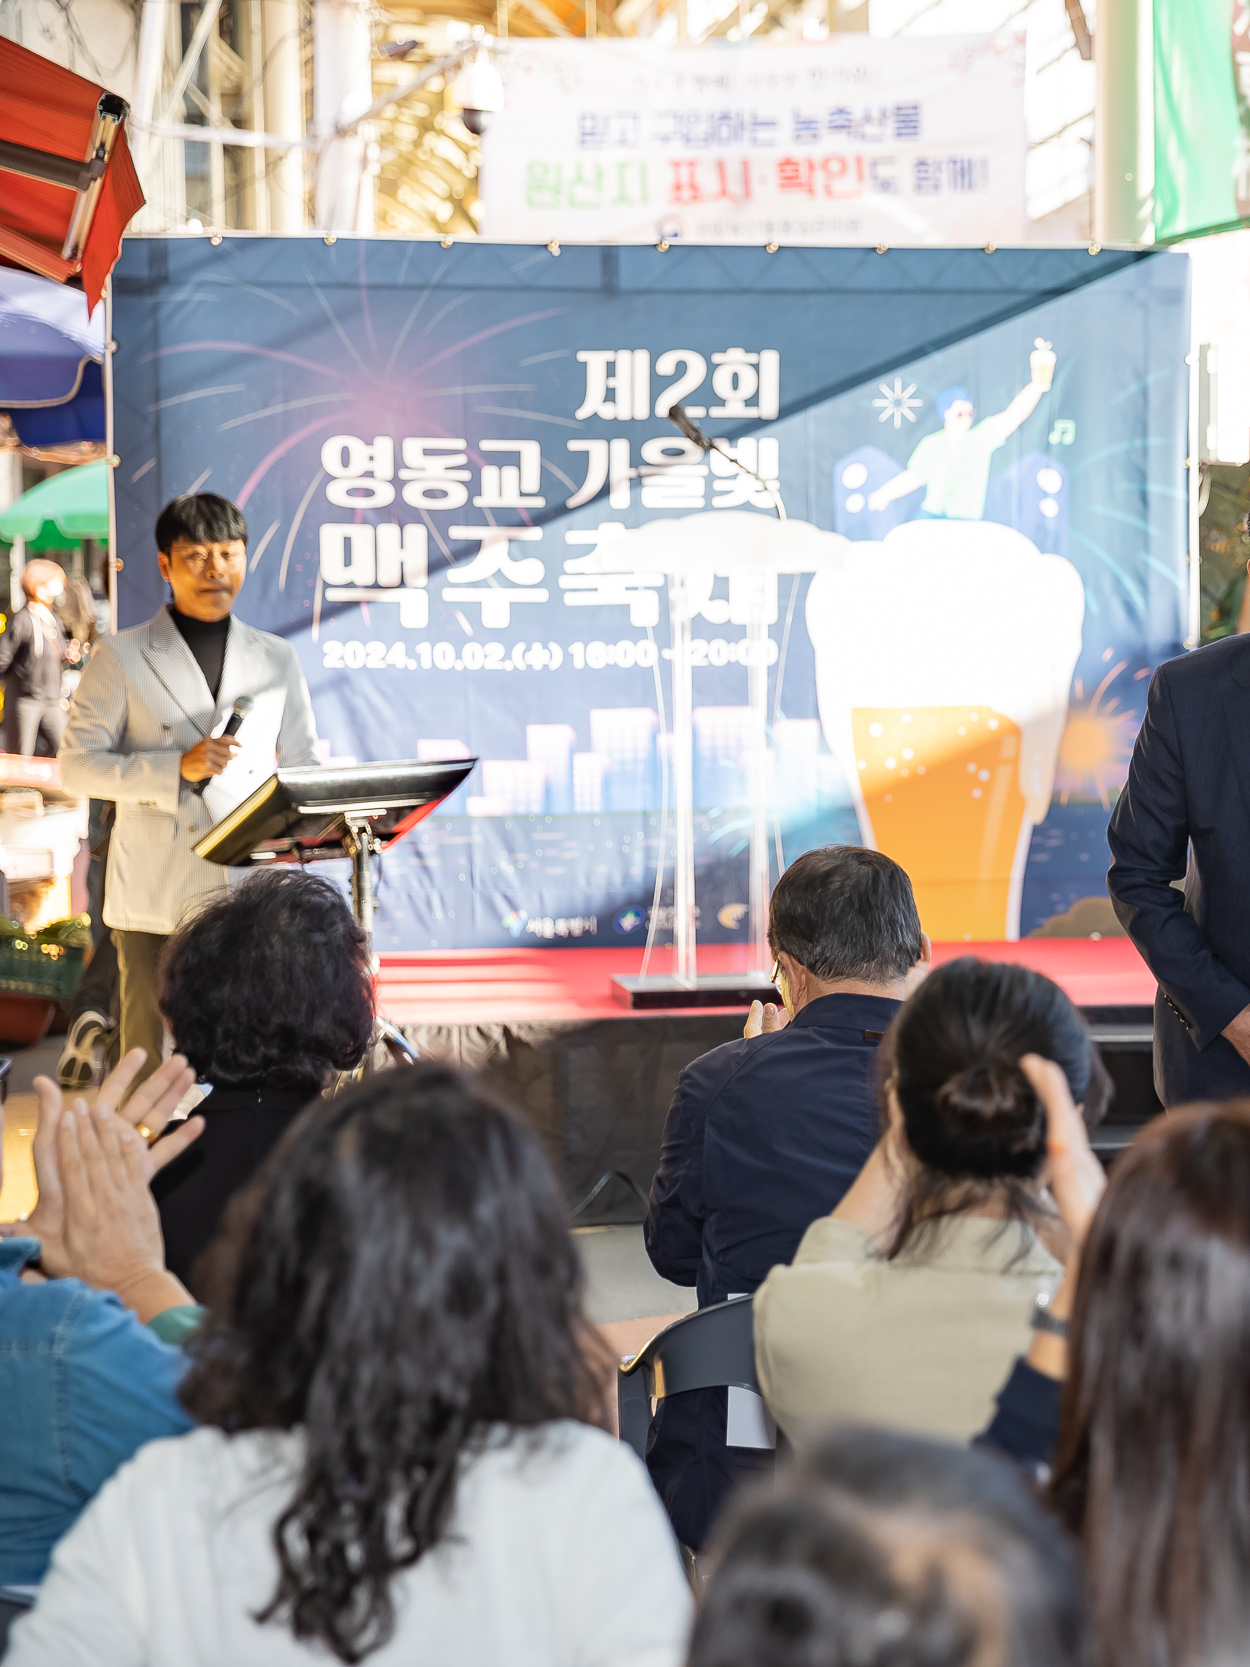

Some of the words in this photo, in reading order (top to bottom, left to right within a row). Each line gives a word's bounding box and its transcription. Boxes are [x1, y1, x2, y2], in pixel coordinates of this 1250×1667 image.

[524, 160, 649, 208] 원산지
[574, 347, 780, 421] 제2회
[320, 435, 546, 510] 영동교
[565, 436, 780, 510] 가을빛
[568, 639, 658, 669] 16:00
